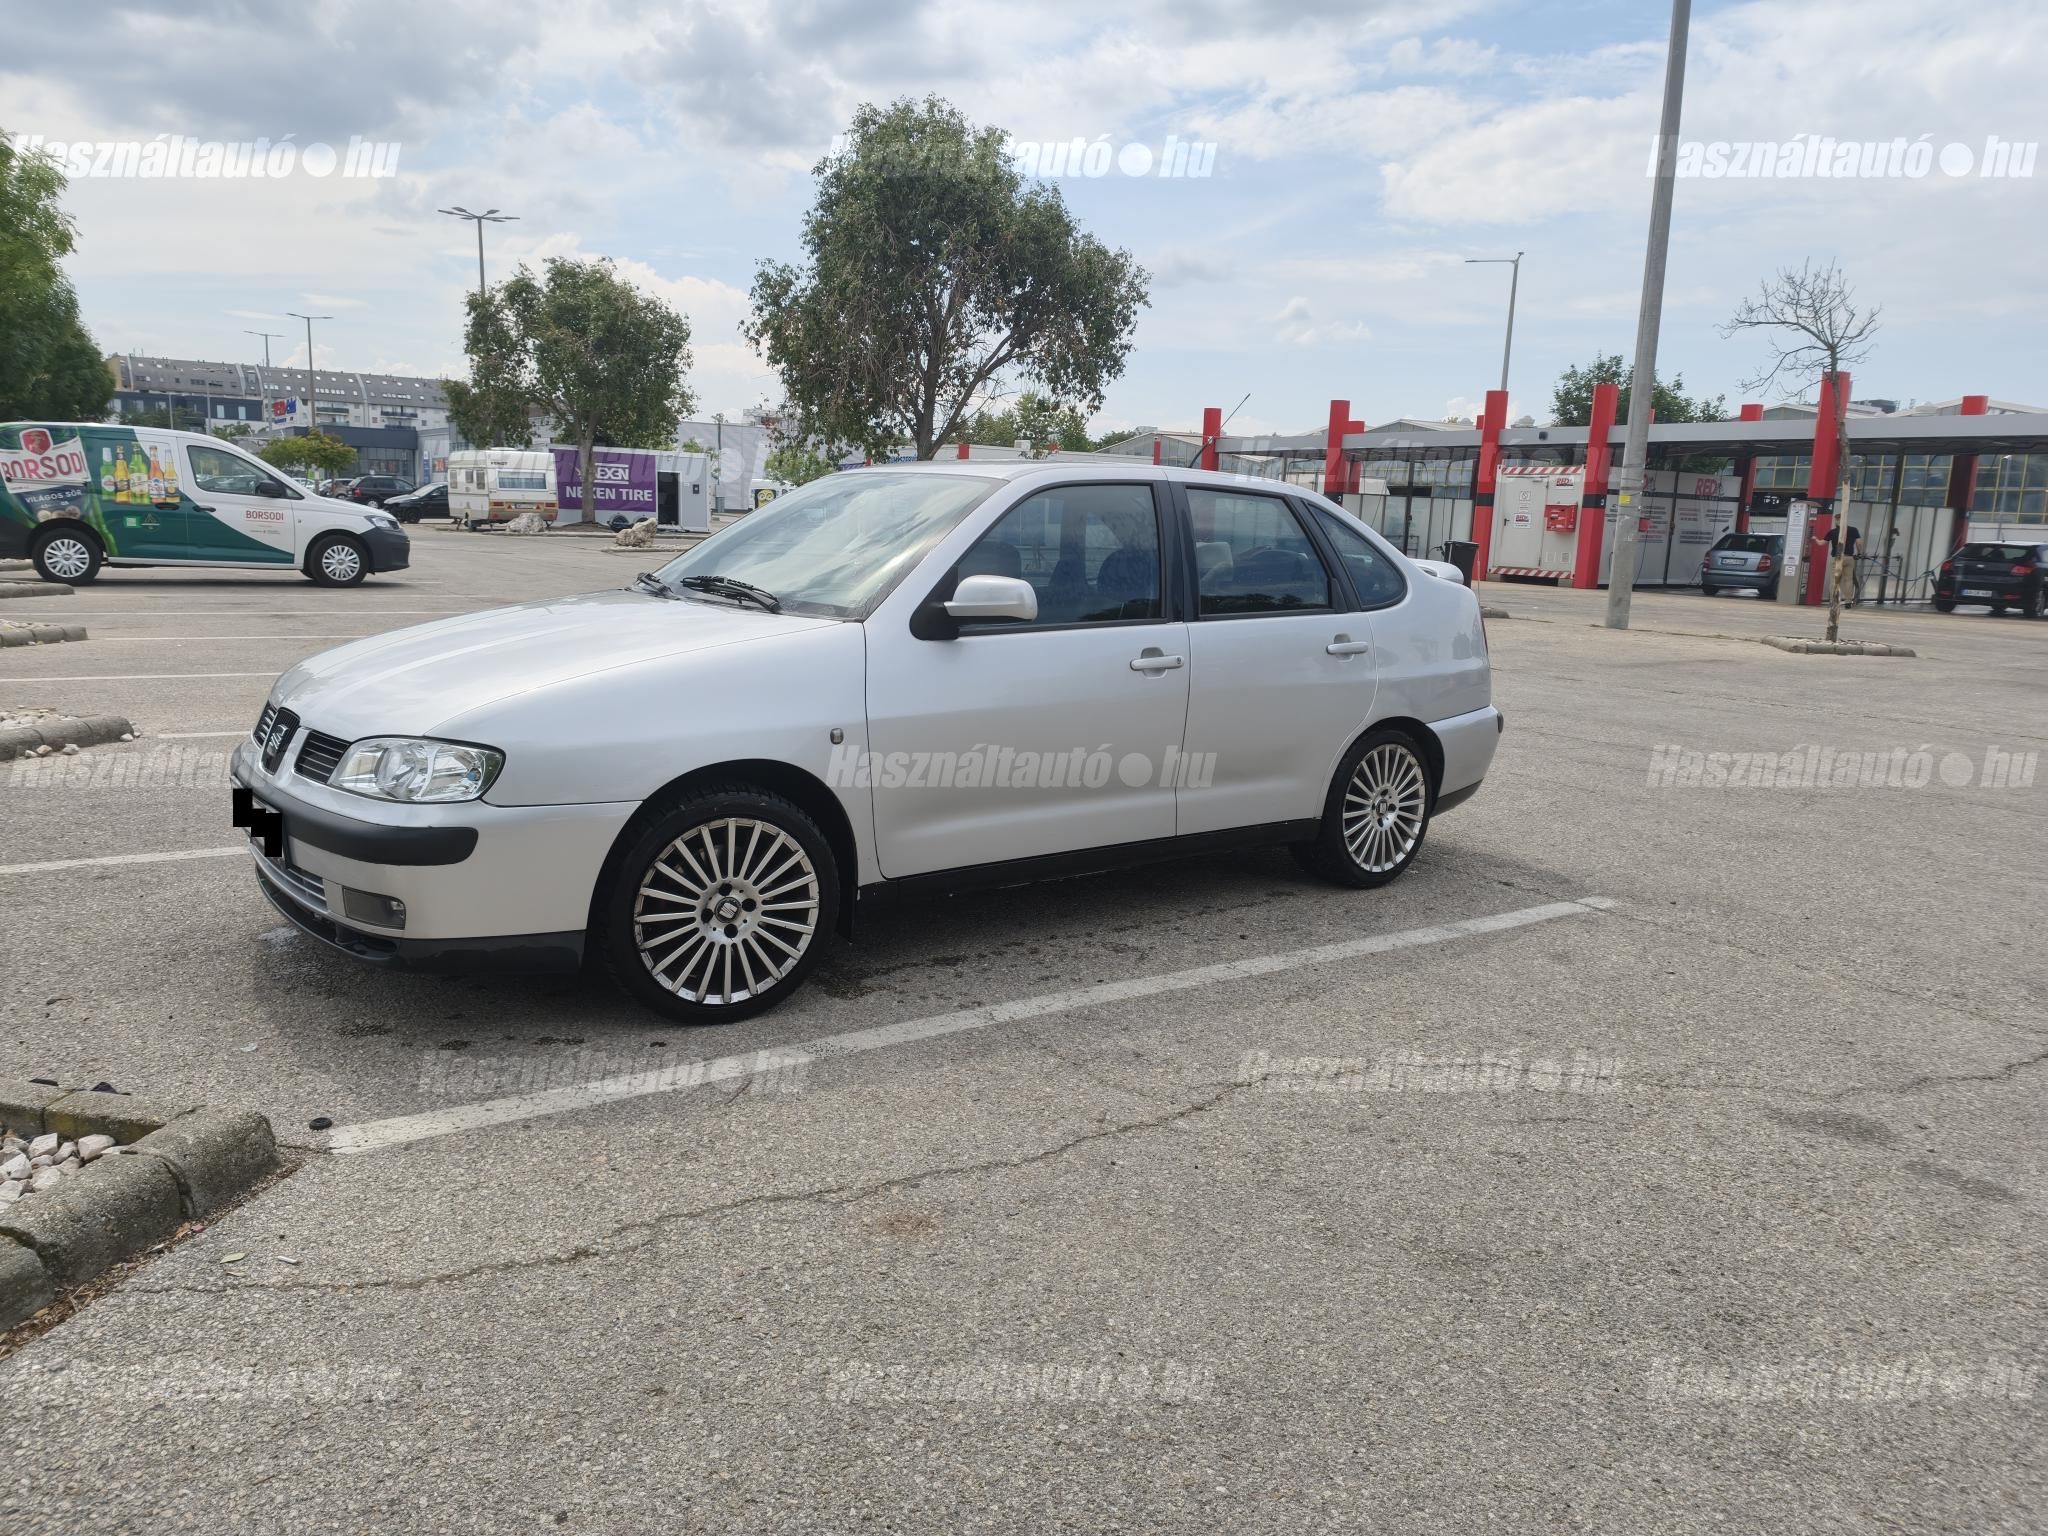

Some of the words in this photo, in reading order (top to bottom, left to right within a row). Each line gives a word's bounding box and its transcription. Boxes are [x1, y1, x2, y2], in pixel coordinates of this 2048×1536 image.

[0, 450, 87, 480] BORSODI
[619, 488, 653, 502] TIRE
[245, 510, 284, 521] BORSODI
